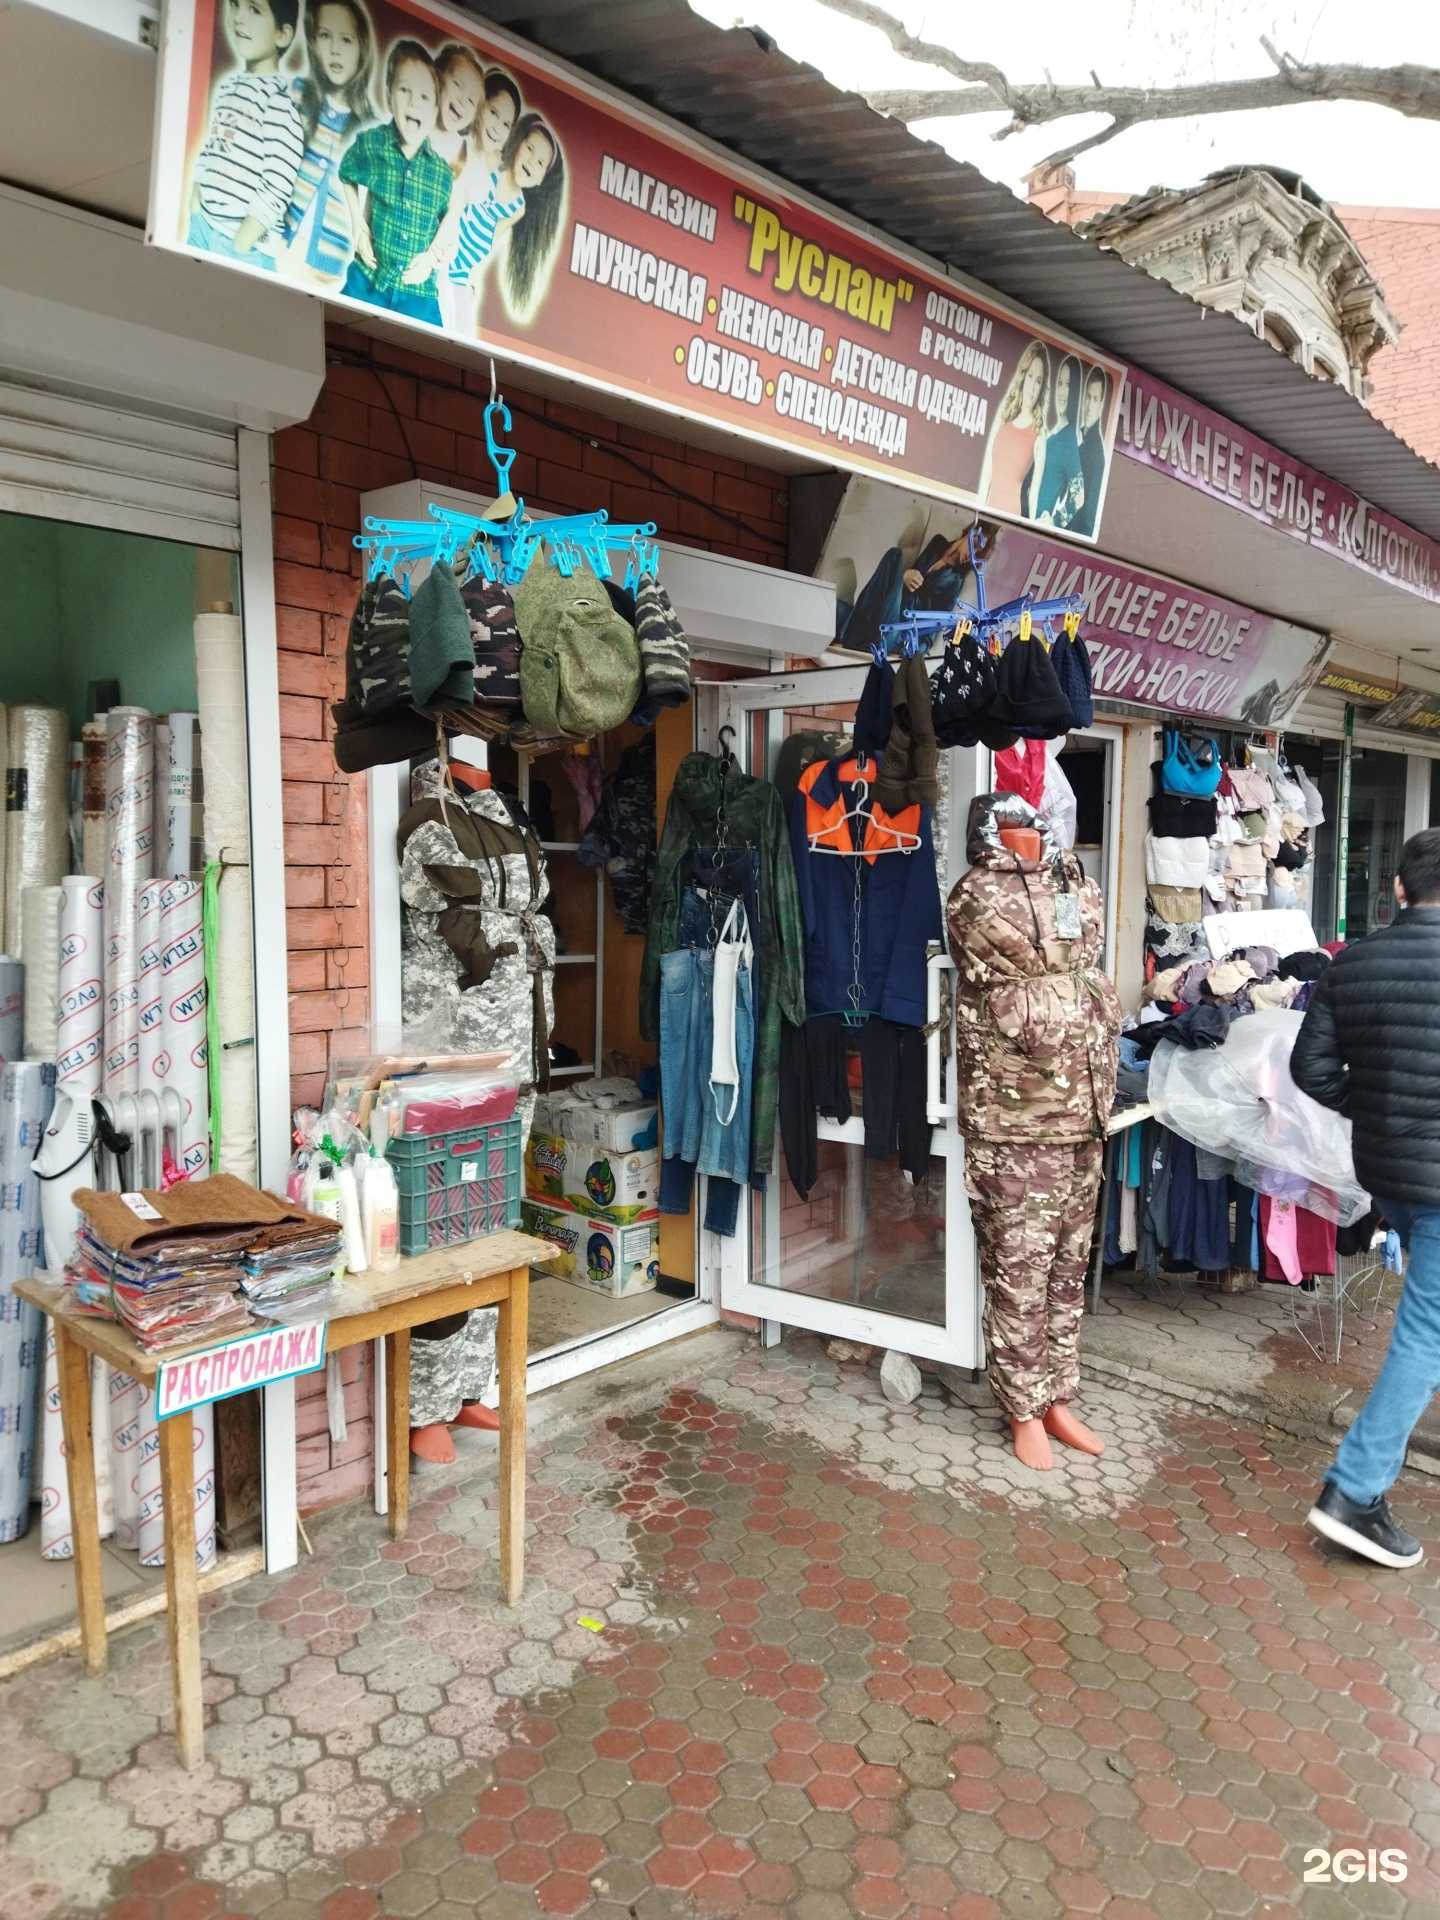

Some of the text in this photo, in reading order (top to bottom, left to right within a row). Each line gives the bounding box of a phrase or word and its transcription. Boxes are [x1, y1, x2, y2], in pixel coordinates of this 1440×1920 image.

[600, 154, 718, 243] МАГАЗИН
[733, 195, 914, 333] "Руслан"
[569, 223, 989, 436] МУЖСКАЯ ЖЕНСКАЯ ДЕТСКАЯ ОДЕЖДА
[919, 326, 1003, 388] В РОЗНИЦУ
[924, 290, 993, 347] ОПТОМ И
[686, 336, 908, 456] ОБУВЬ СПЕЦОДЕЖДА
[1249, 457, 1326, 540] БЕЛЬЕ
[1020, 553, 1167, 638] НИЖНЕЕ
[1157, 597, 1250, 662] БЕЛЬЕ
[1136, 658, 1239, 713] НОСКИ
[67, 986, 97, 1010] PVC
[164, 1326, 317, 1408] РАСПРОДАЖА
